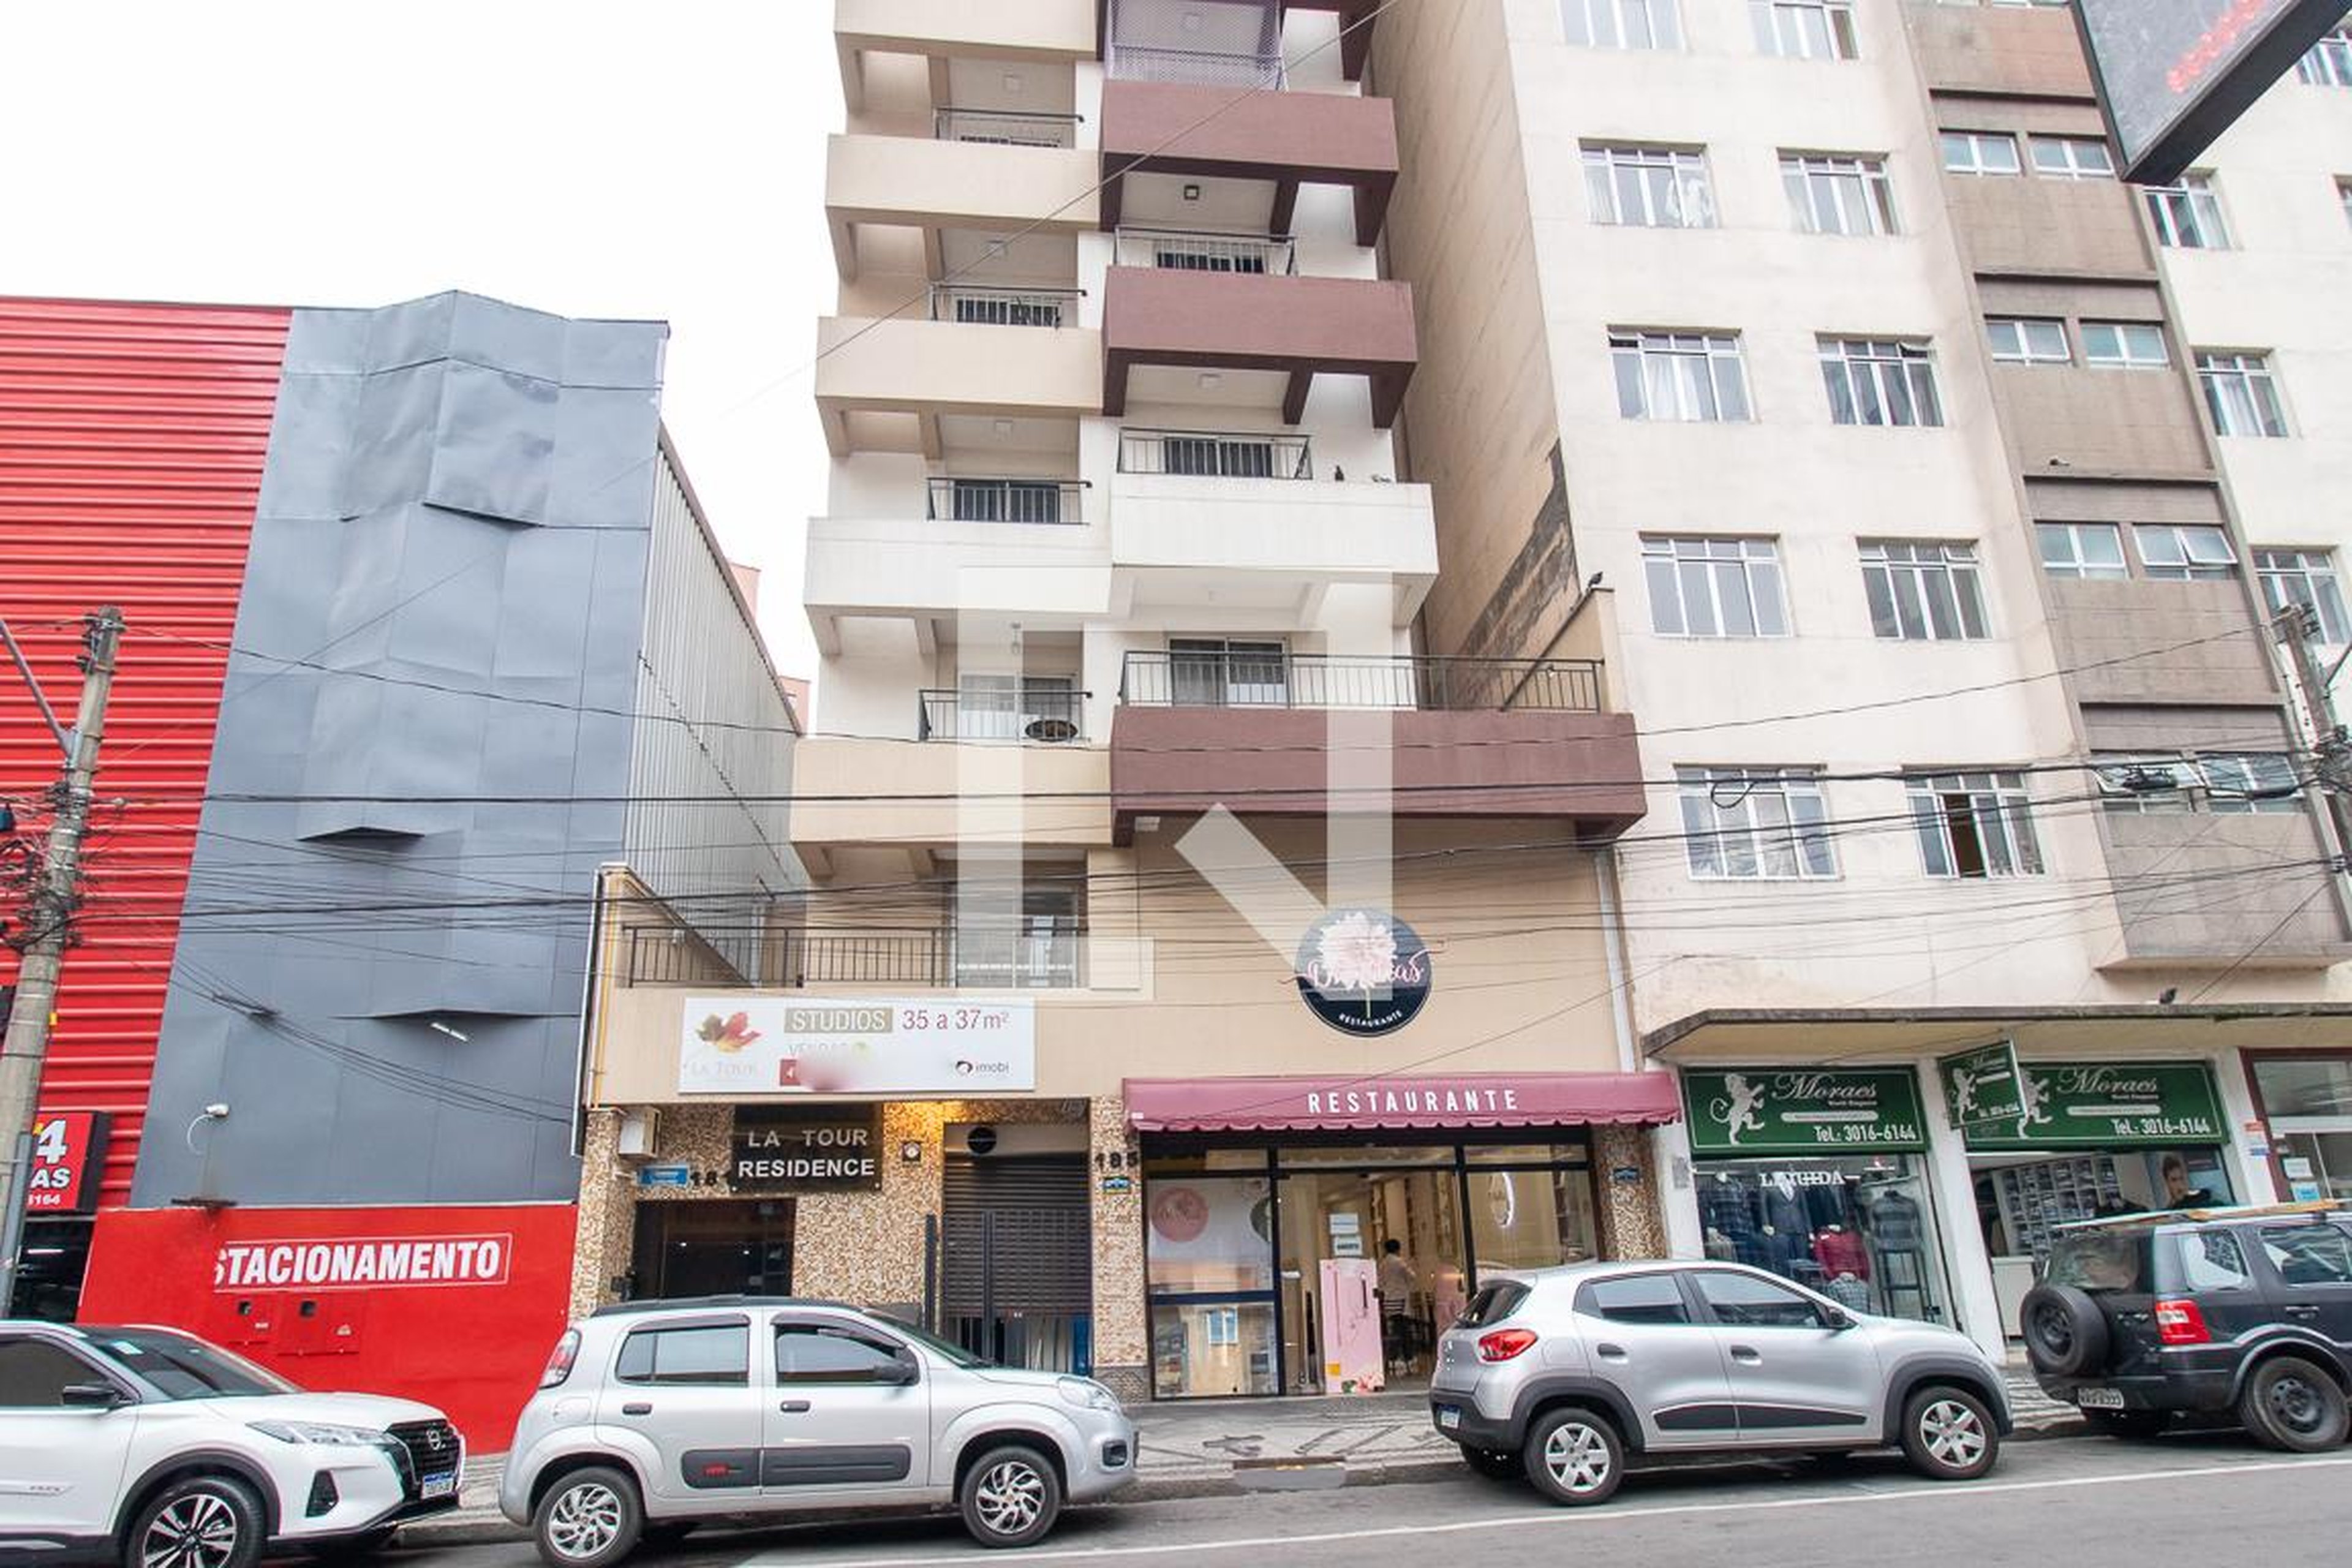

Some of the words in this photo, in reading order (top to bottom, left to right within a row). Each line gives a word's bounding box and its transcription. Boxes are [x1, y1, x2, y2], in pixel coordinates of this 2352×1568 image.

[792, 1010, 886, 1031] STUDIOS
[902, 1010, 928, 1030] 35
[936, 1014, 949, 1030] a
[1338, 1009, 1403, 1028] RESTAURANTE
[975, 1061, 1009, 1074] imobi
[1771, 1073, 1877, 1099] Moraes
[2056, 1068, 2157, 1094] Moraes
[1308, 1089, 1518, 1114] RESTAURANTE
[748, 1130, 781, 1148] LA
[801, 1128, 868, 1147] TOUR
[1844, 1125, 1916, 1142] 3016-6144
[738, 1158, 875, 1178] RESIDENCE
